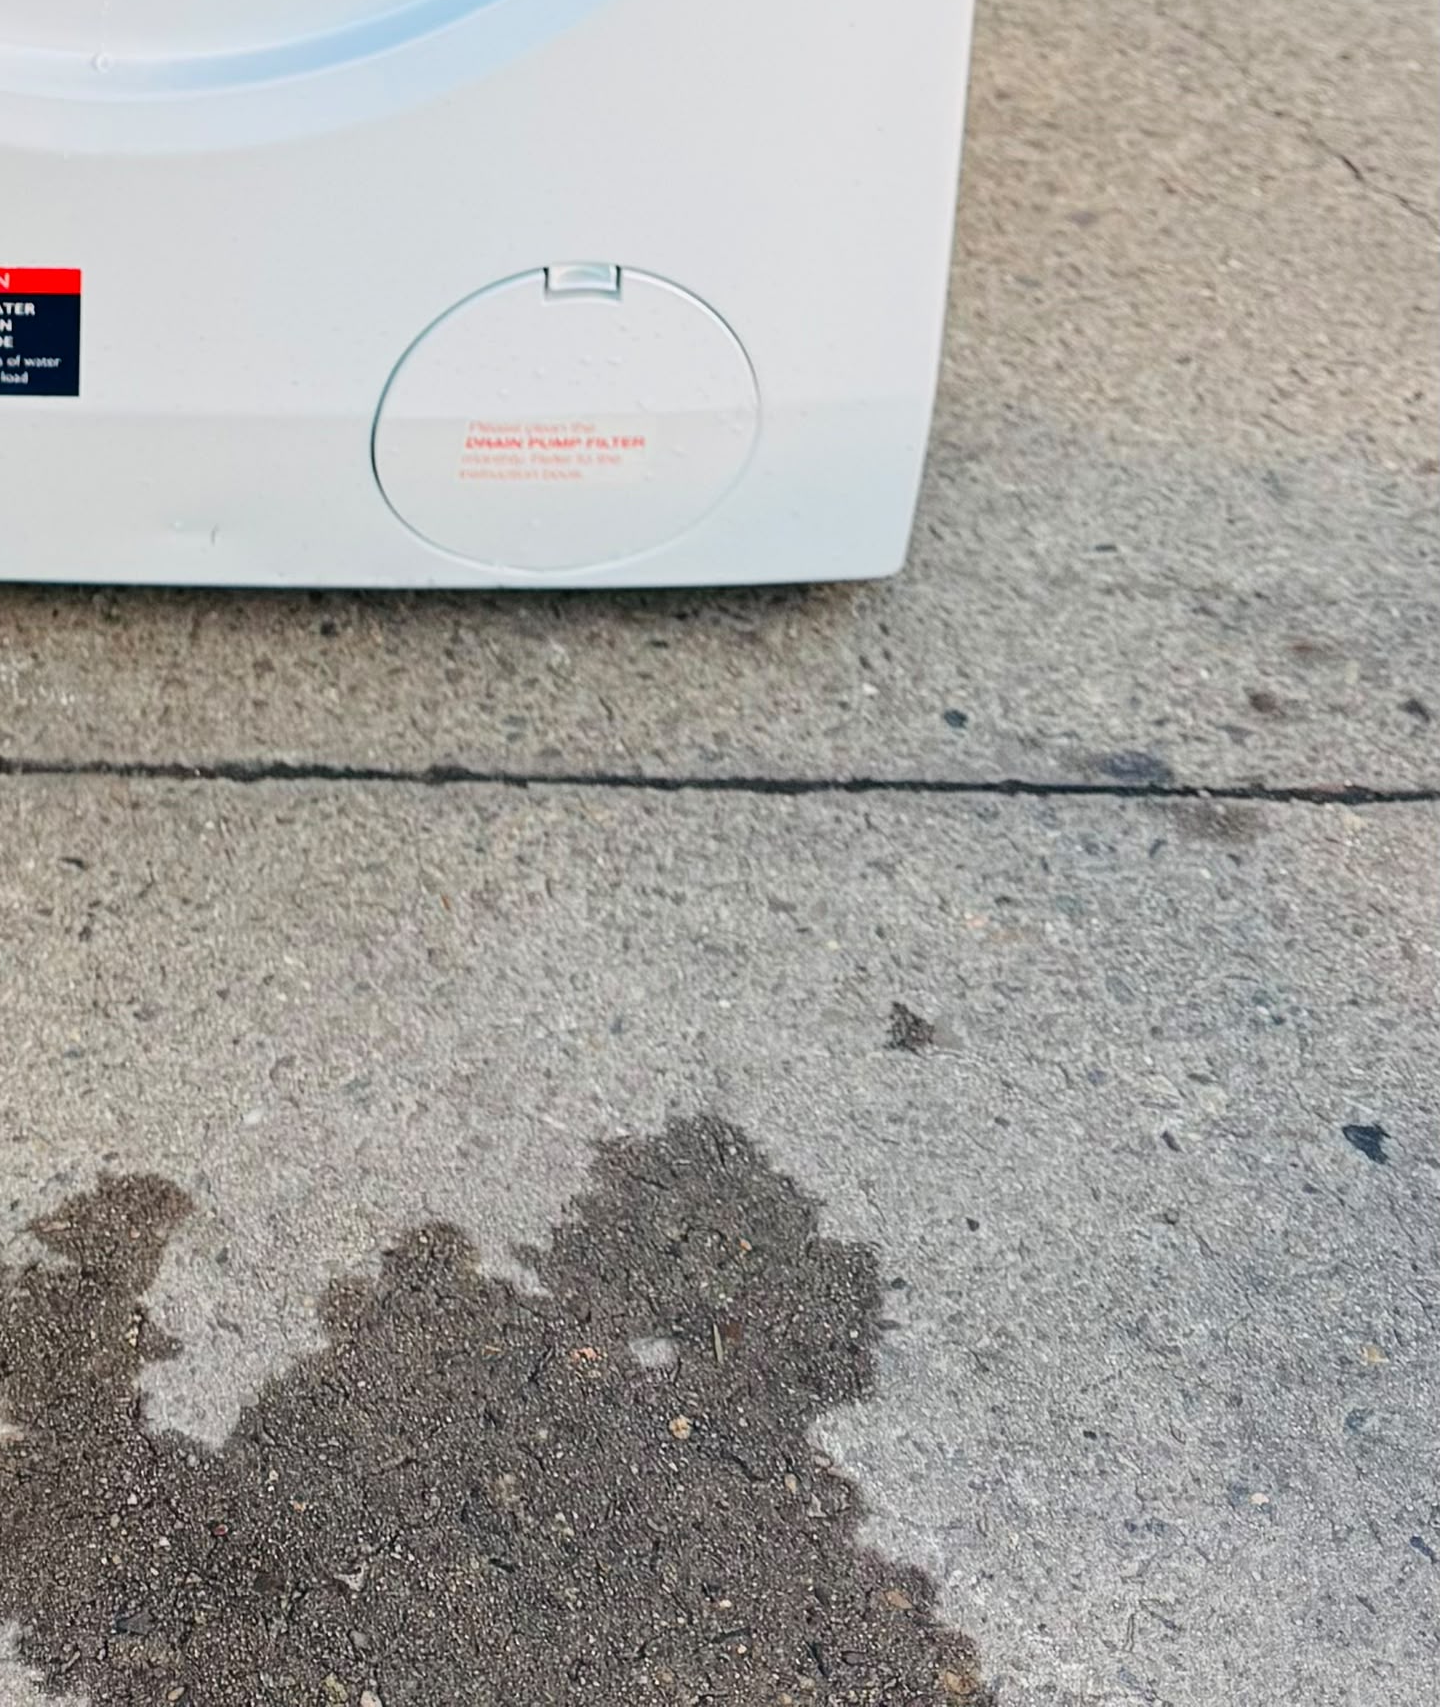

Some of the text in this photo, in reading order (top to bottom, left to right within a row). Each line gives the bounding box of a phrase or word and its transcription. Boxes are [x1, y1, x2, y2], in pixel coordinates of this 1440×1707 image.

[6, 354, 22, 368] of
[24, 356, 61, 368] water
[0, 371, 28, 385] load
[465, 436, 646, 450] DRAIN PUMP FILTER
